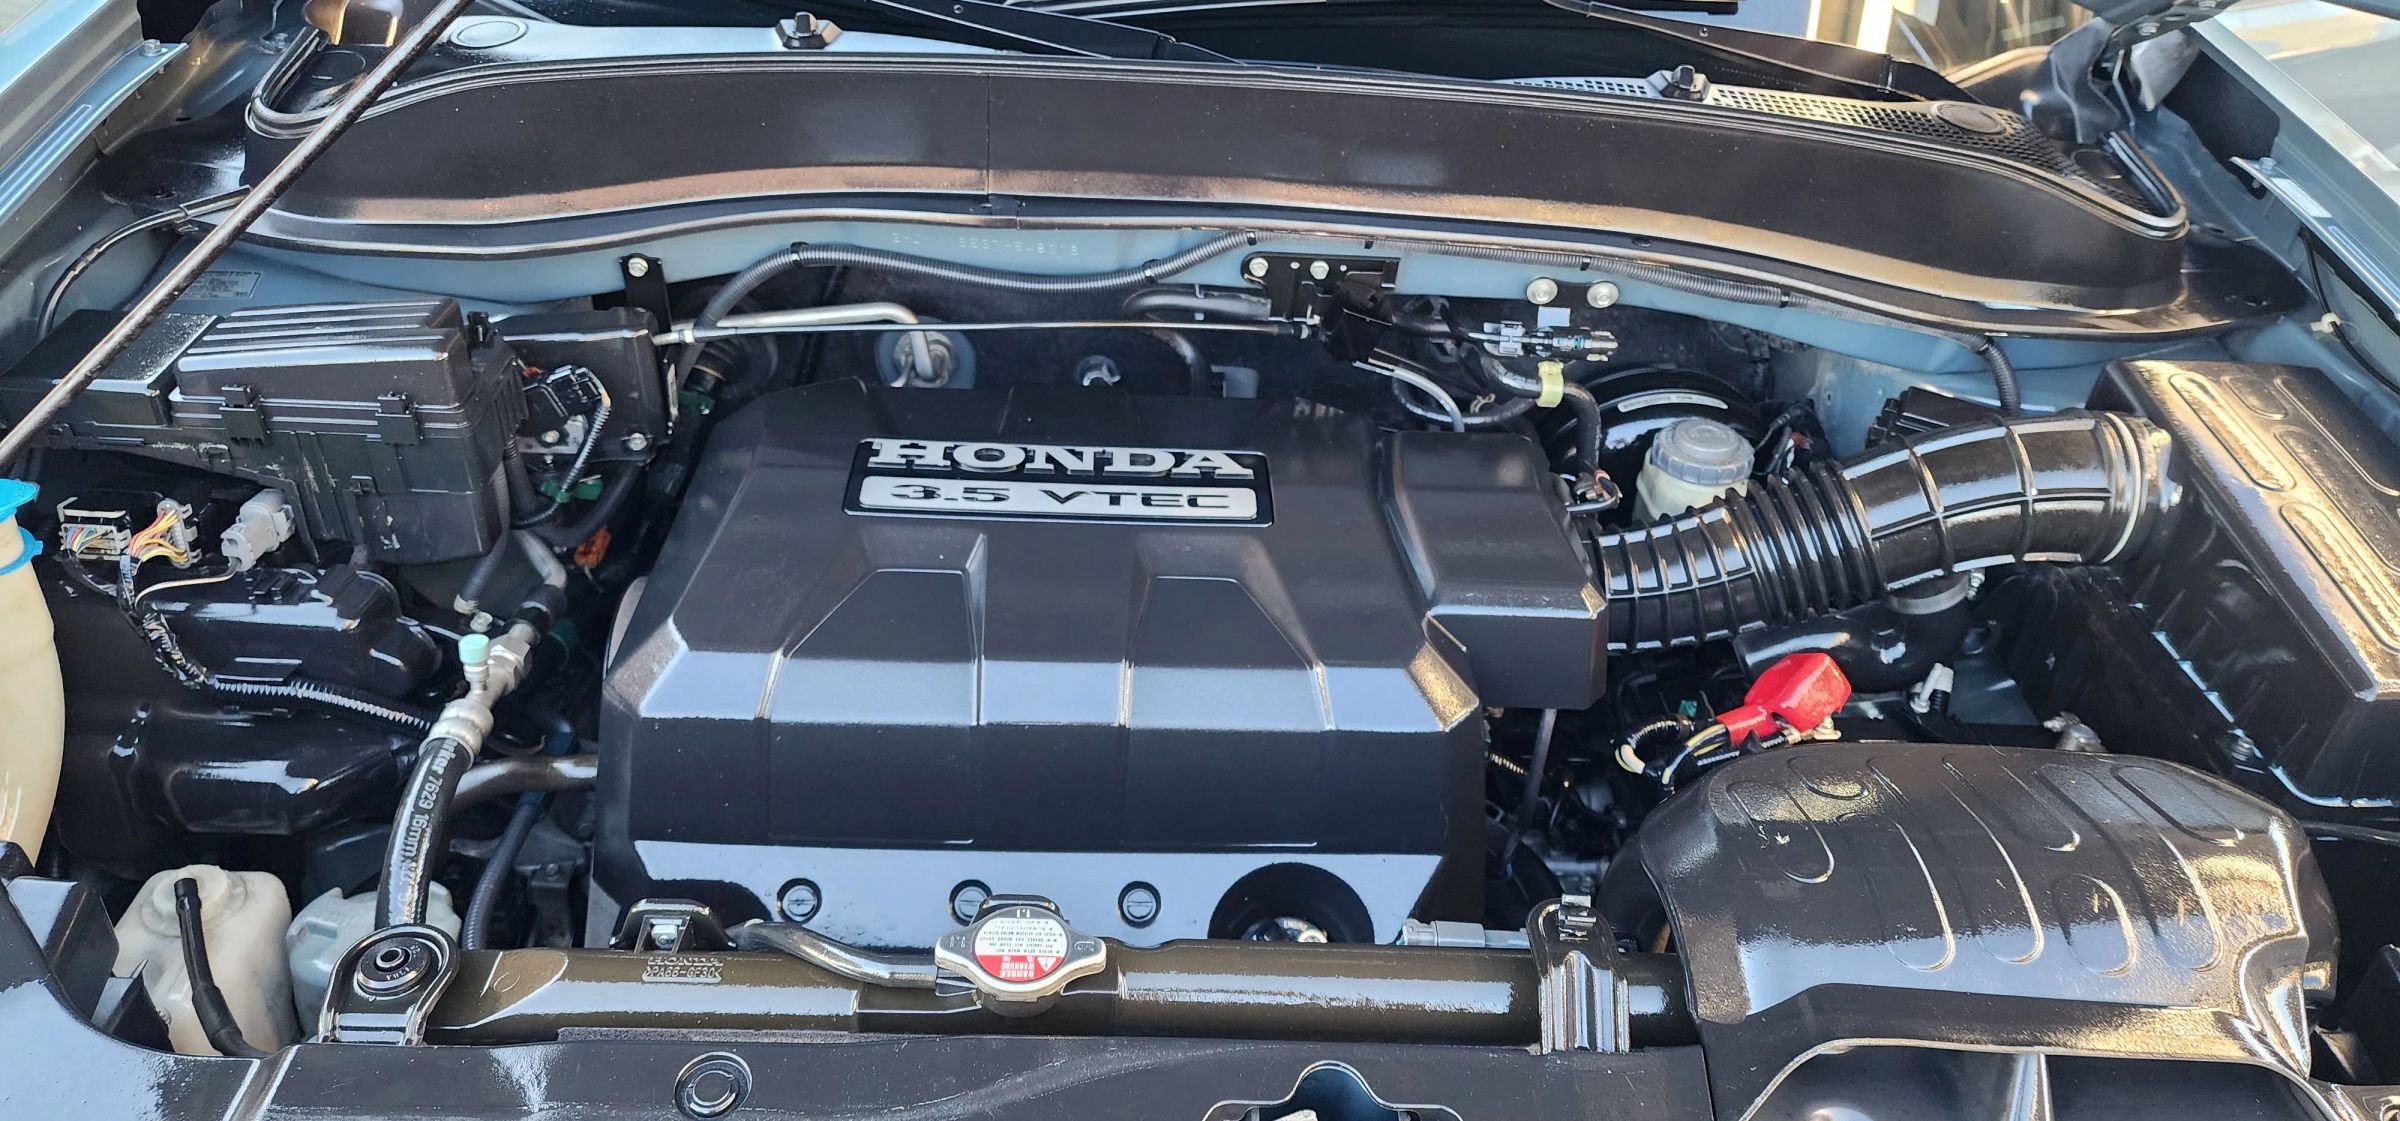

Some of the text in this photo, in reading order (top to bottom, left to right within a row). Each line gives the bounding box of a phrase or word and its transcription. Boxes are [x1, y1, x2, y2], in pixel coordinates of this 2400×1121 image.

[867, 438, 1254, 479] HONDA
[890, 484, 1230, 509] 3.5 VTEC
[419, 775, 442, 810] 7629
[401, 814, 429, 857] 16mm
